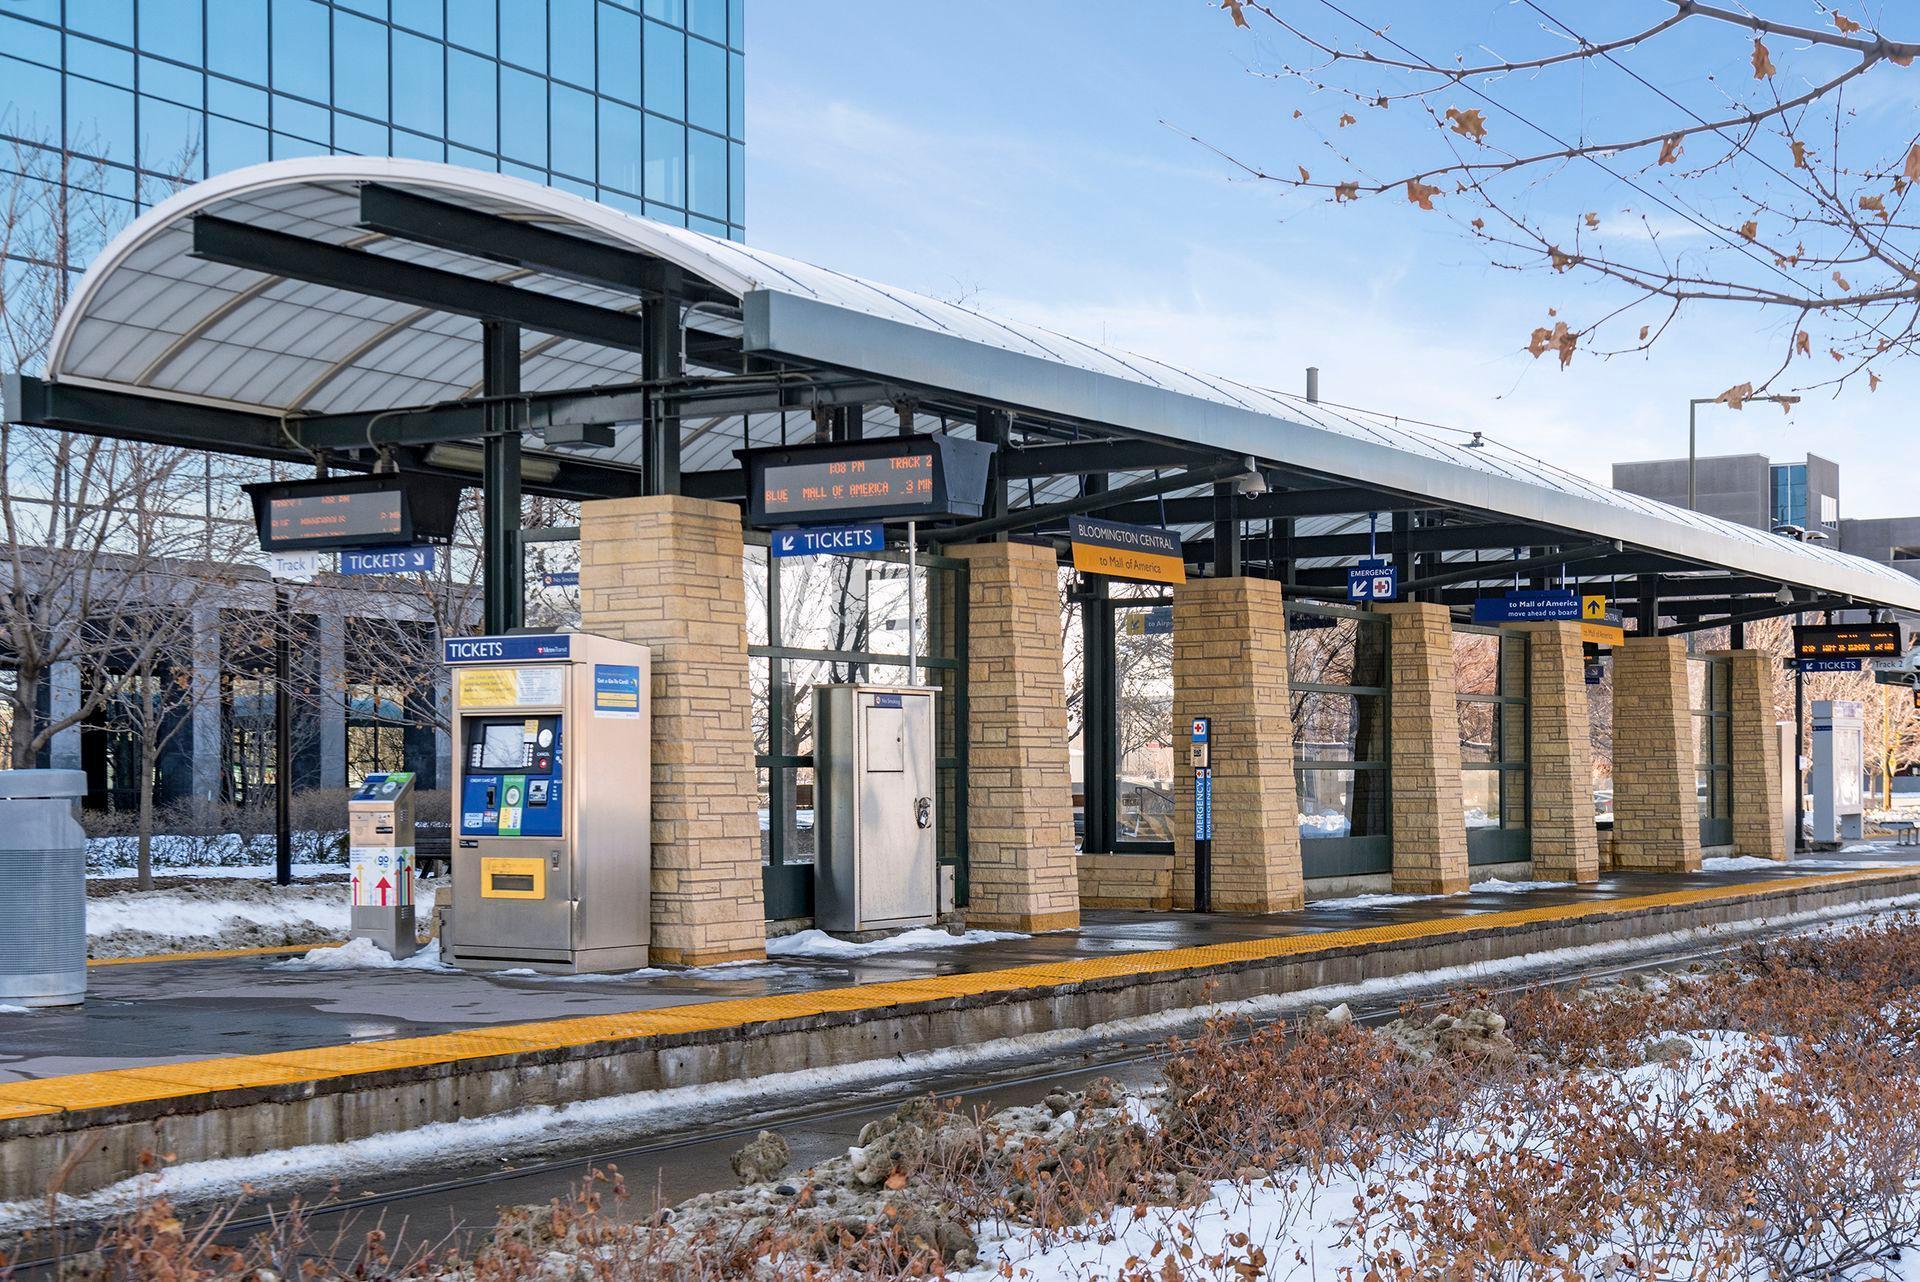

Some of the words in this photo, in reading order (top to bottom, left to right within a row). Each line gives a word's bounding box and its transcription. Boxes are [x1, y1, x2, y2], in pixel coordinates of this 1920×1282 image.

[852, 460, 865, 473] PM
[889, 456, 920, 471] TRACK
[925, 455, 932, 467] 2
[765, 488, 788, 503] BLUE
[803, 486, 827, 500] MALL
[832, 485, 844, 498] OF
[850, 482, 889, 497] AMERICA
[905, 480, 914, 491] 3
[805, 529, 873, 550] TICKETS
[1078, 524, 1139, 546] BLOOMINGTON
[1140, 534, 1174, 550] CENTRAL
[275, 557, 306, 572] Track
[349, 553, 405, 570] TICKETS
[1100, 557, 1107, 567] to
[1109, 557, 1123, 568] Mall
[1126, 558, 1133, 569] of
[1134, 560, 1162, 574] America
[1350, 568, 1394, 577] EMERGENCY
[449, 642, 503, 658] TICKETS
[1818, 661, 1856, 669] TICKETS
[1197, 780, 1205, 839] EMERGENCY
[378, 855, 389, 866] go
